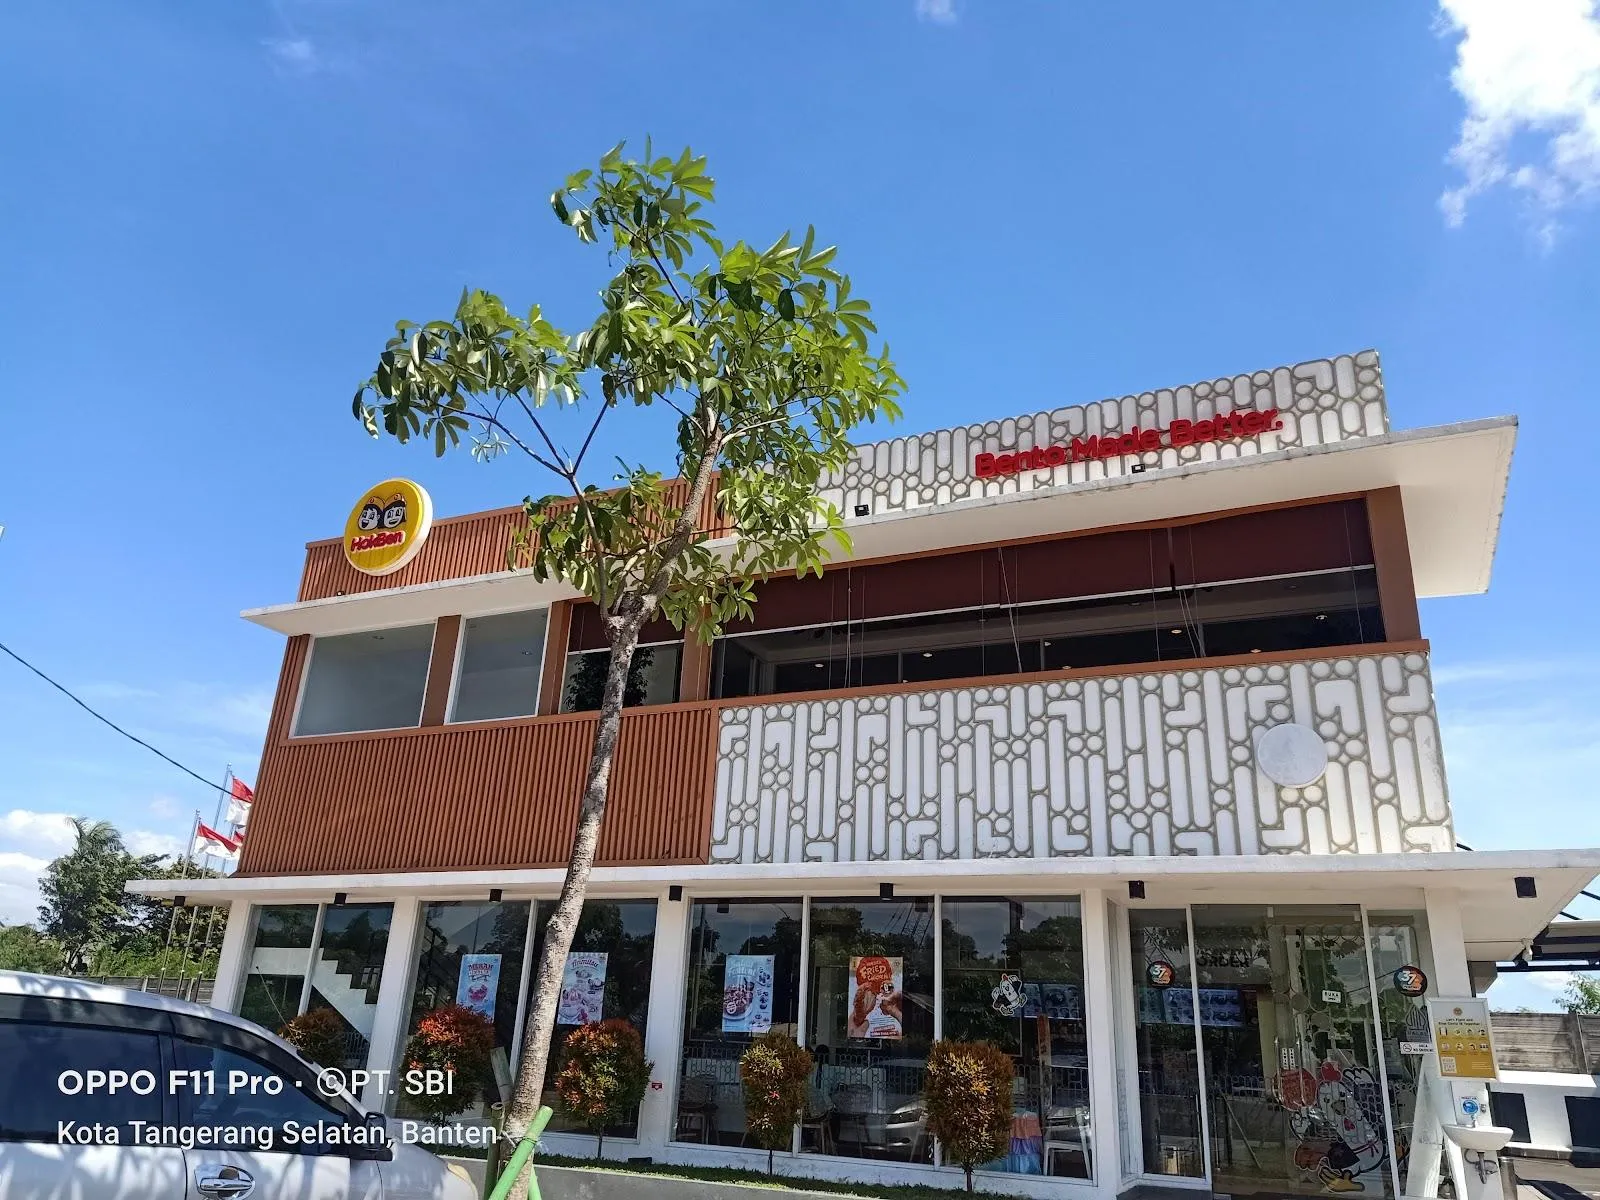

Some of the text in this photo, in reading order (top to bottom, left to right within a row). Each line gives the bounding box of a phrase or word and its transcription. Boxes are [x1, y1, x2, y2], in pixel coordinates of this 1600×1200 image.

[976, 408, 1283, 479] Bento Made Better.
[350, 531, 404, 552] HokBen
